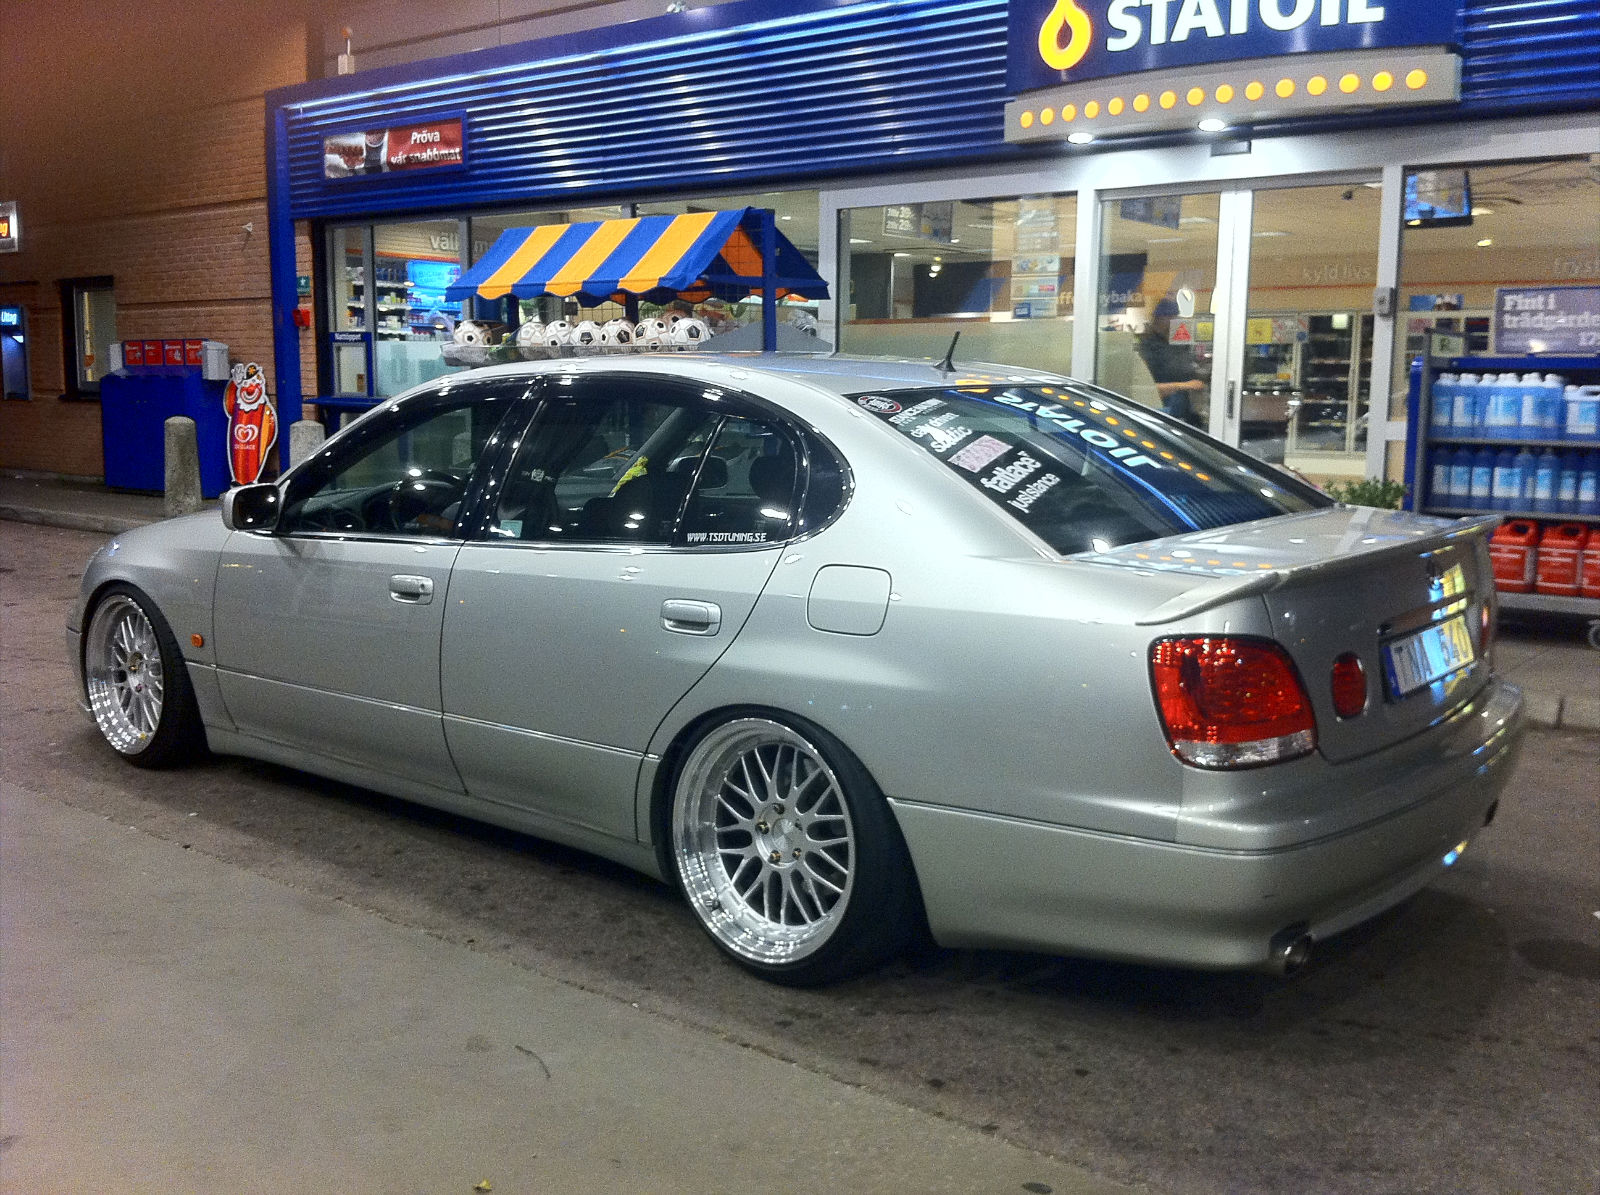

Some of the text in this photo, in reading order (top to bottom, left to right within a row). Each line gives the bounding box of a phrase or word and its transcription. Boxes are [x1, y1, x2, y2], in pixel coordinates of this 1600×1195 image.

[410, 130, 440, 144] Pröva
[980, 457, 1042, 494] fatlace
[687, 532, 768, 542] WWW.TSDTUNING.SE
